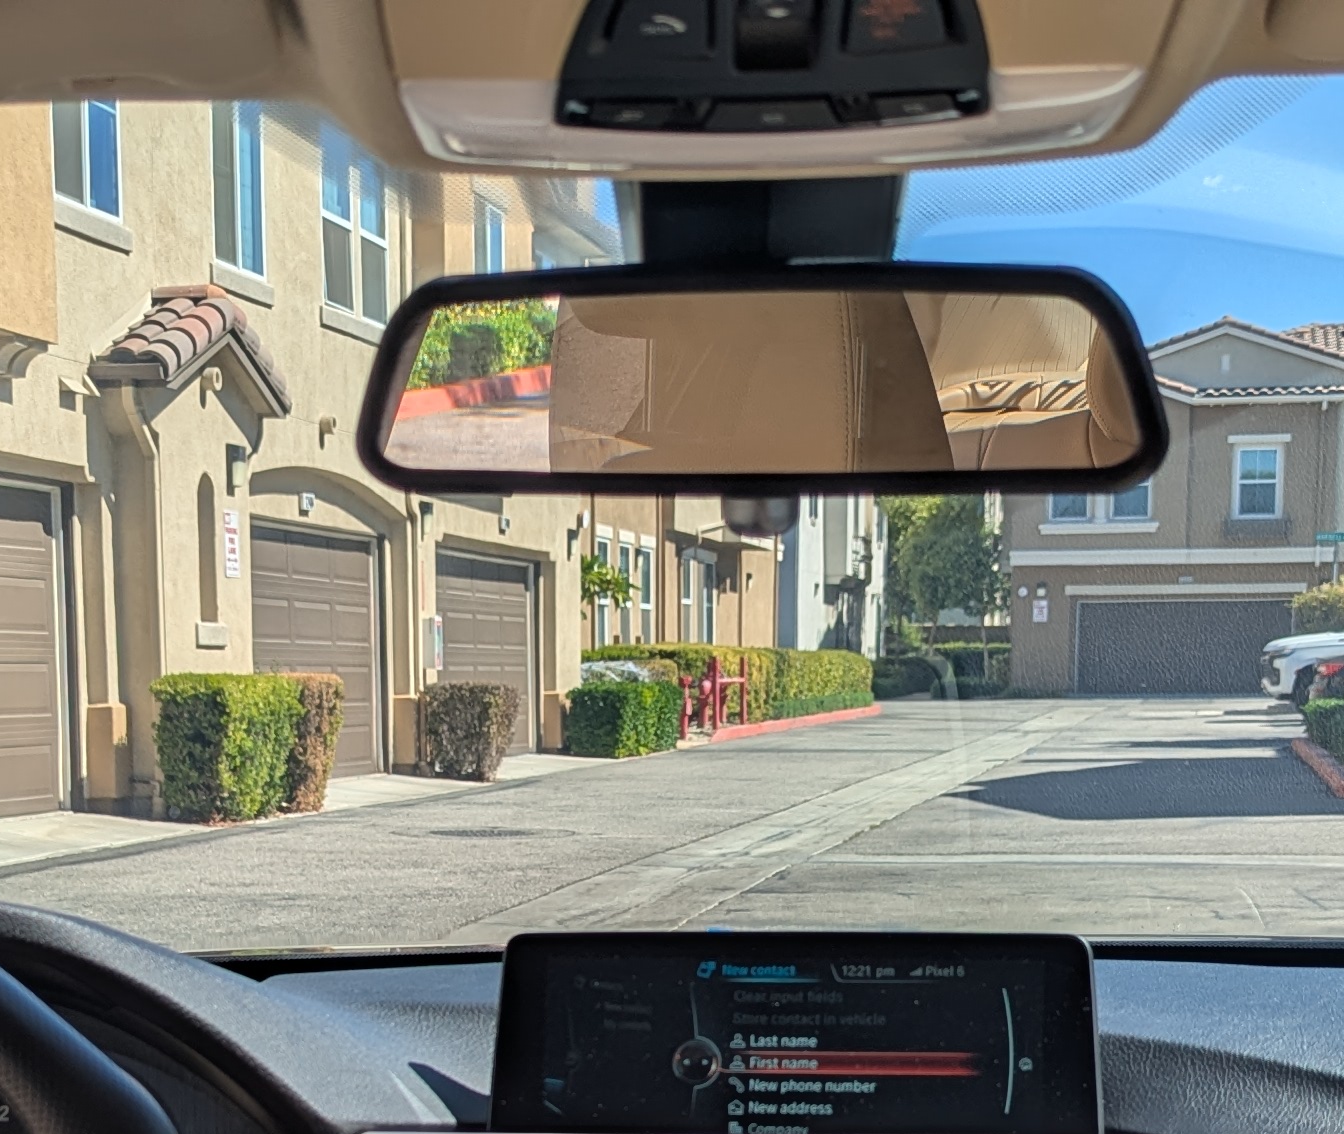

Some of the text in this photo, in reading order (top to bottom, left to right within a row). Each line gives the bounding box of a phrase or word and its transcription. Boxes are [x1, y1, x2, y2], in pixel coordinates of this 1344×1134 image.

[721, 964, 796, 977] New contact
[875, 967, 895, 979] pm
[925, 965, 955, 978] Pixel
[771, 1013, 820, 1026] contact
[823, 1012, 836, 1025] in
[840, 1013, 887, 1026] vehicle
[750, 1034, 818, 1048] Last name
[750, 1057, 818, 1070] First name
[749, 1079, 876, 1096] New phone number
[749, 1101, 833, 1116] New address
